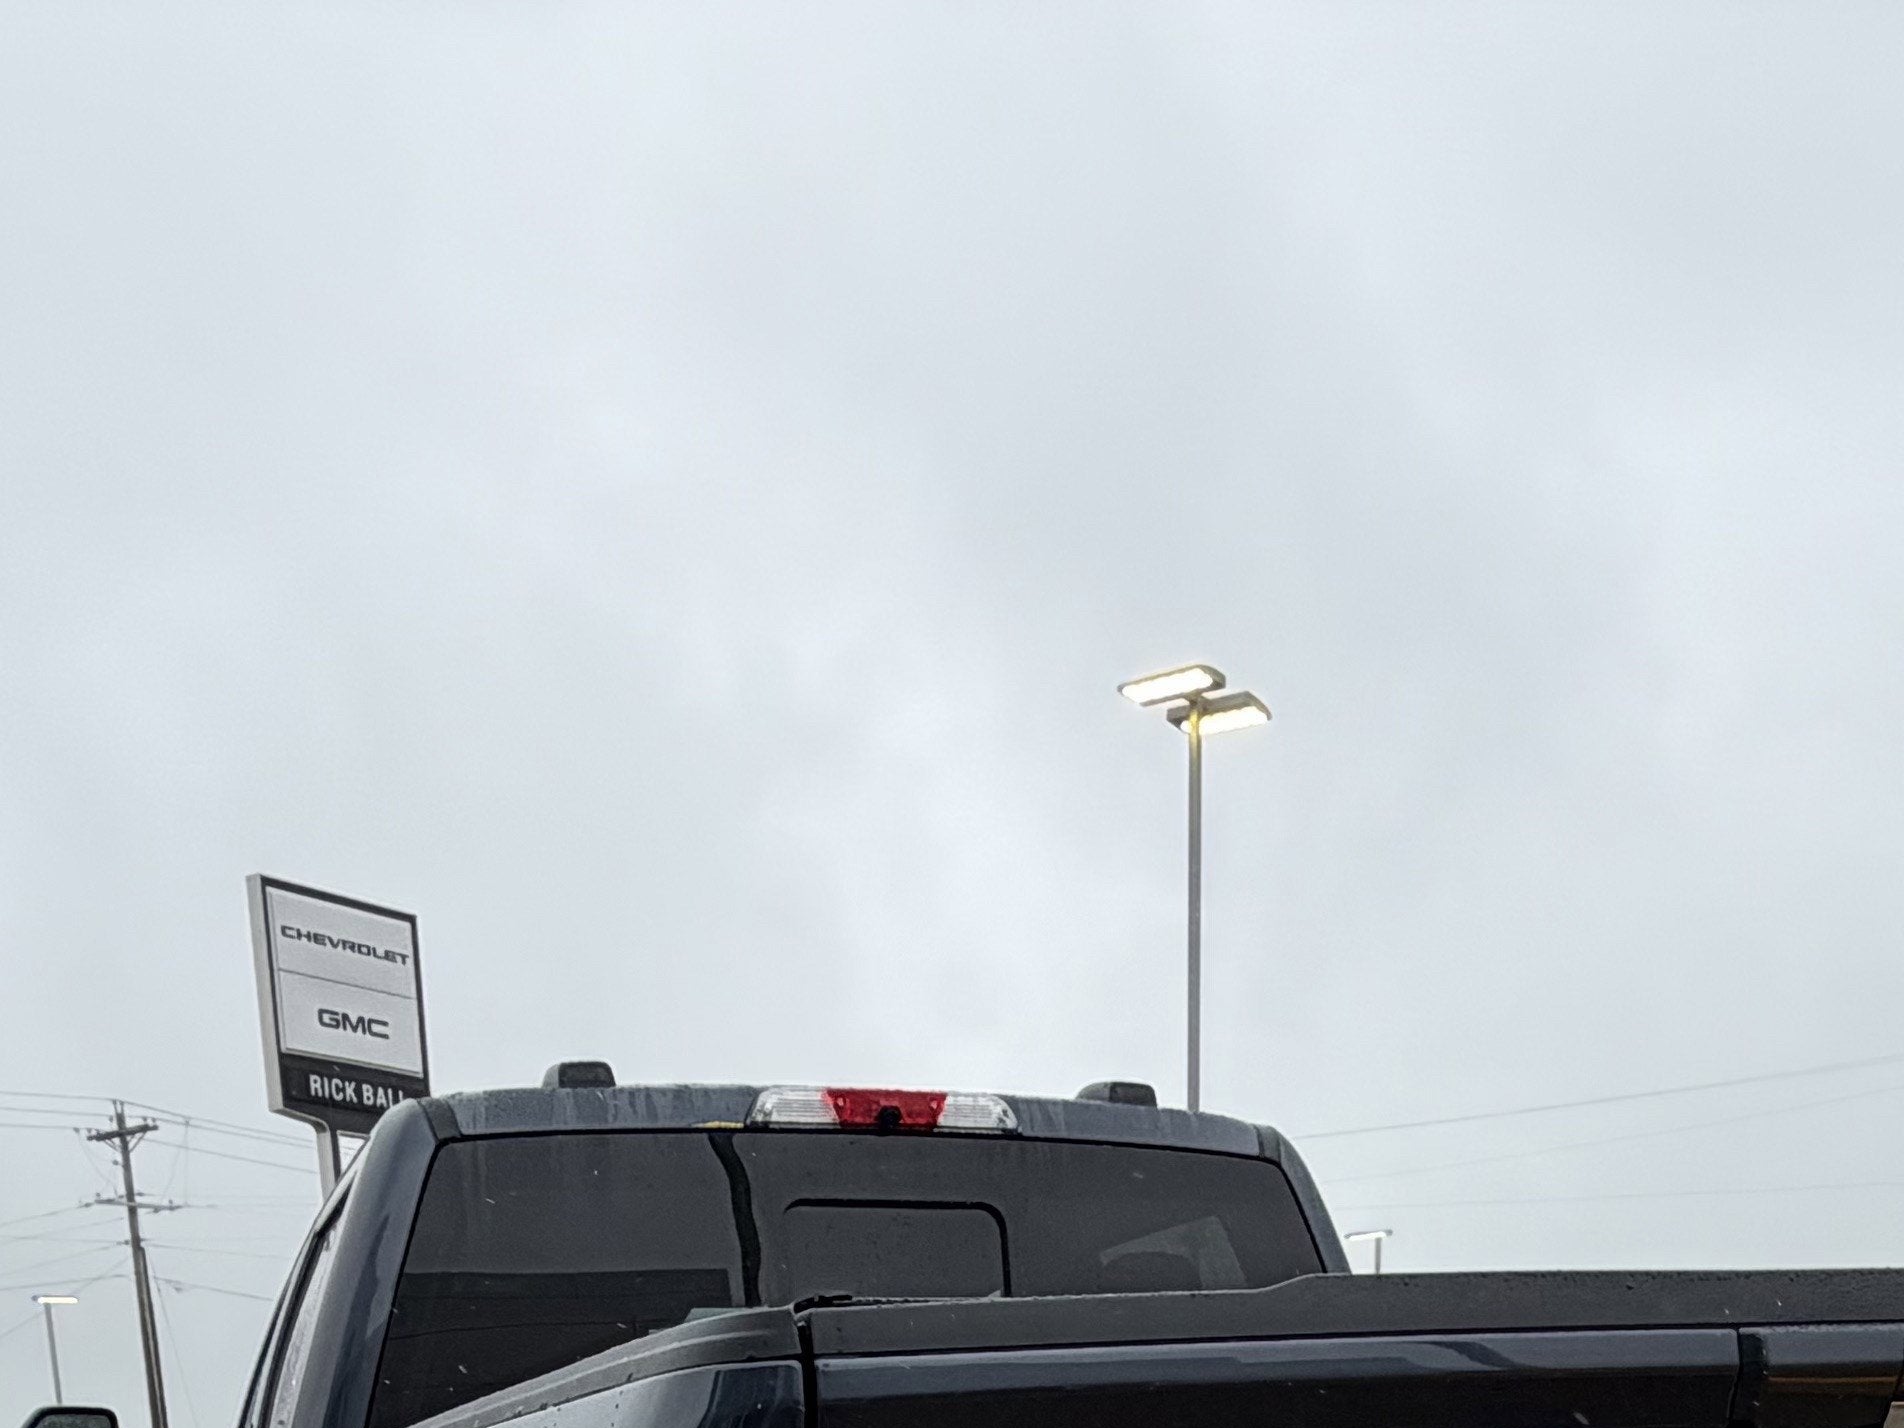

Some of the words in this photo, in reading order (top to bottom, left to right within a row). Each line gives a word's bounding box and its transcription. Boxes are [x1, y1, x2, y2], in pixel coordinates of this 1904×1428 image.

[280, 925, 409, 965] CHEVROLET
[317, 1008, 390, 1040] GMC
[308, 1074, 357, 1104] RICK
